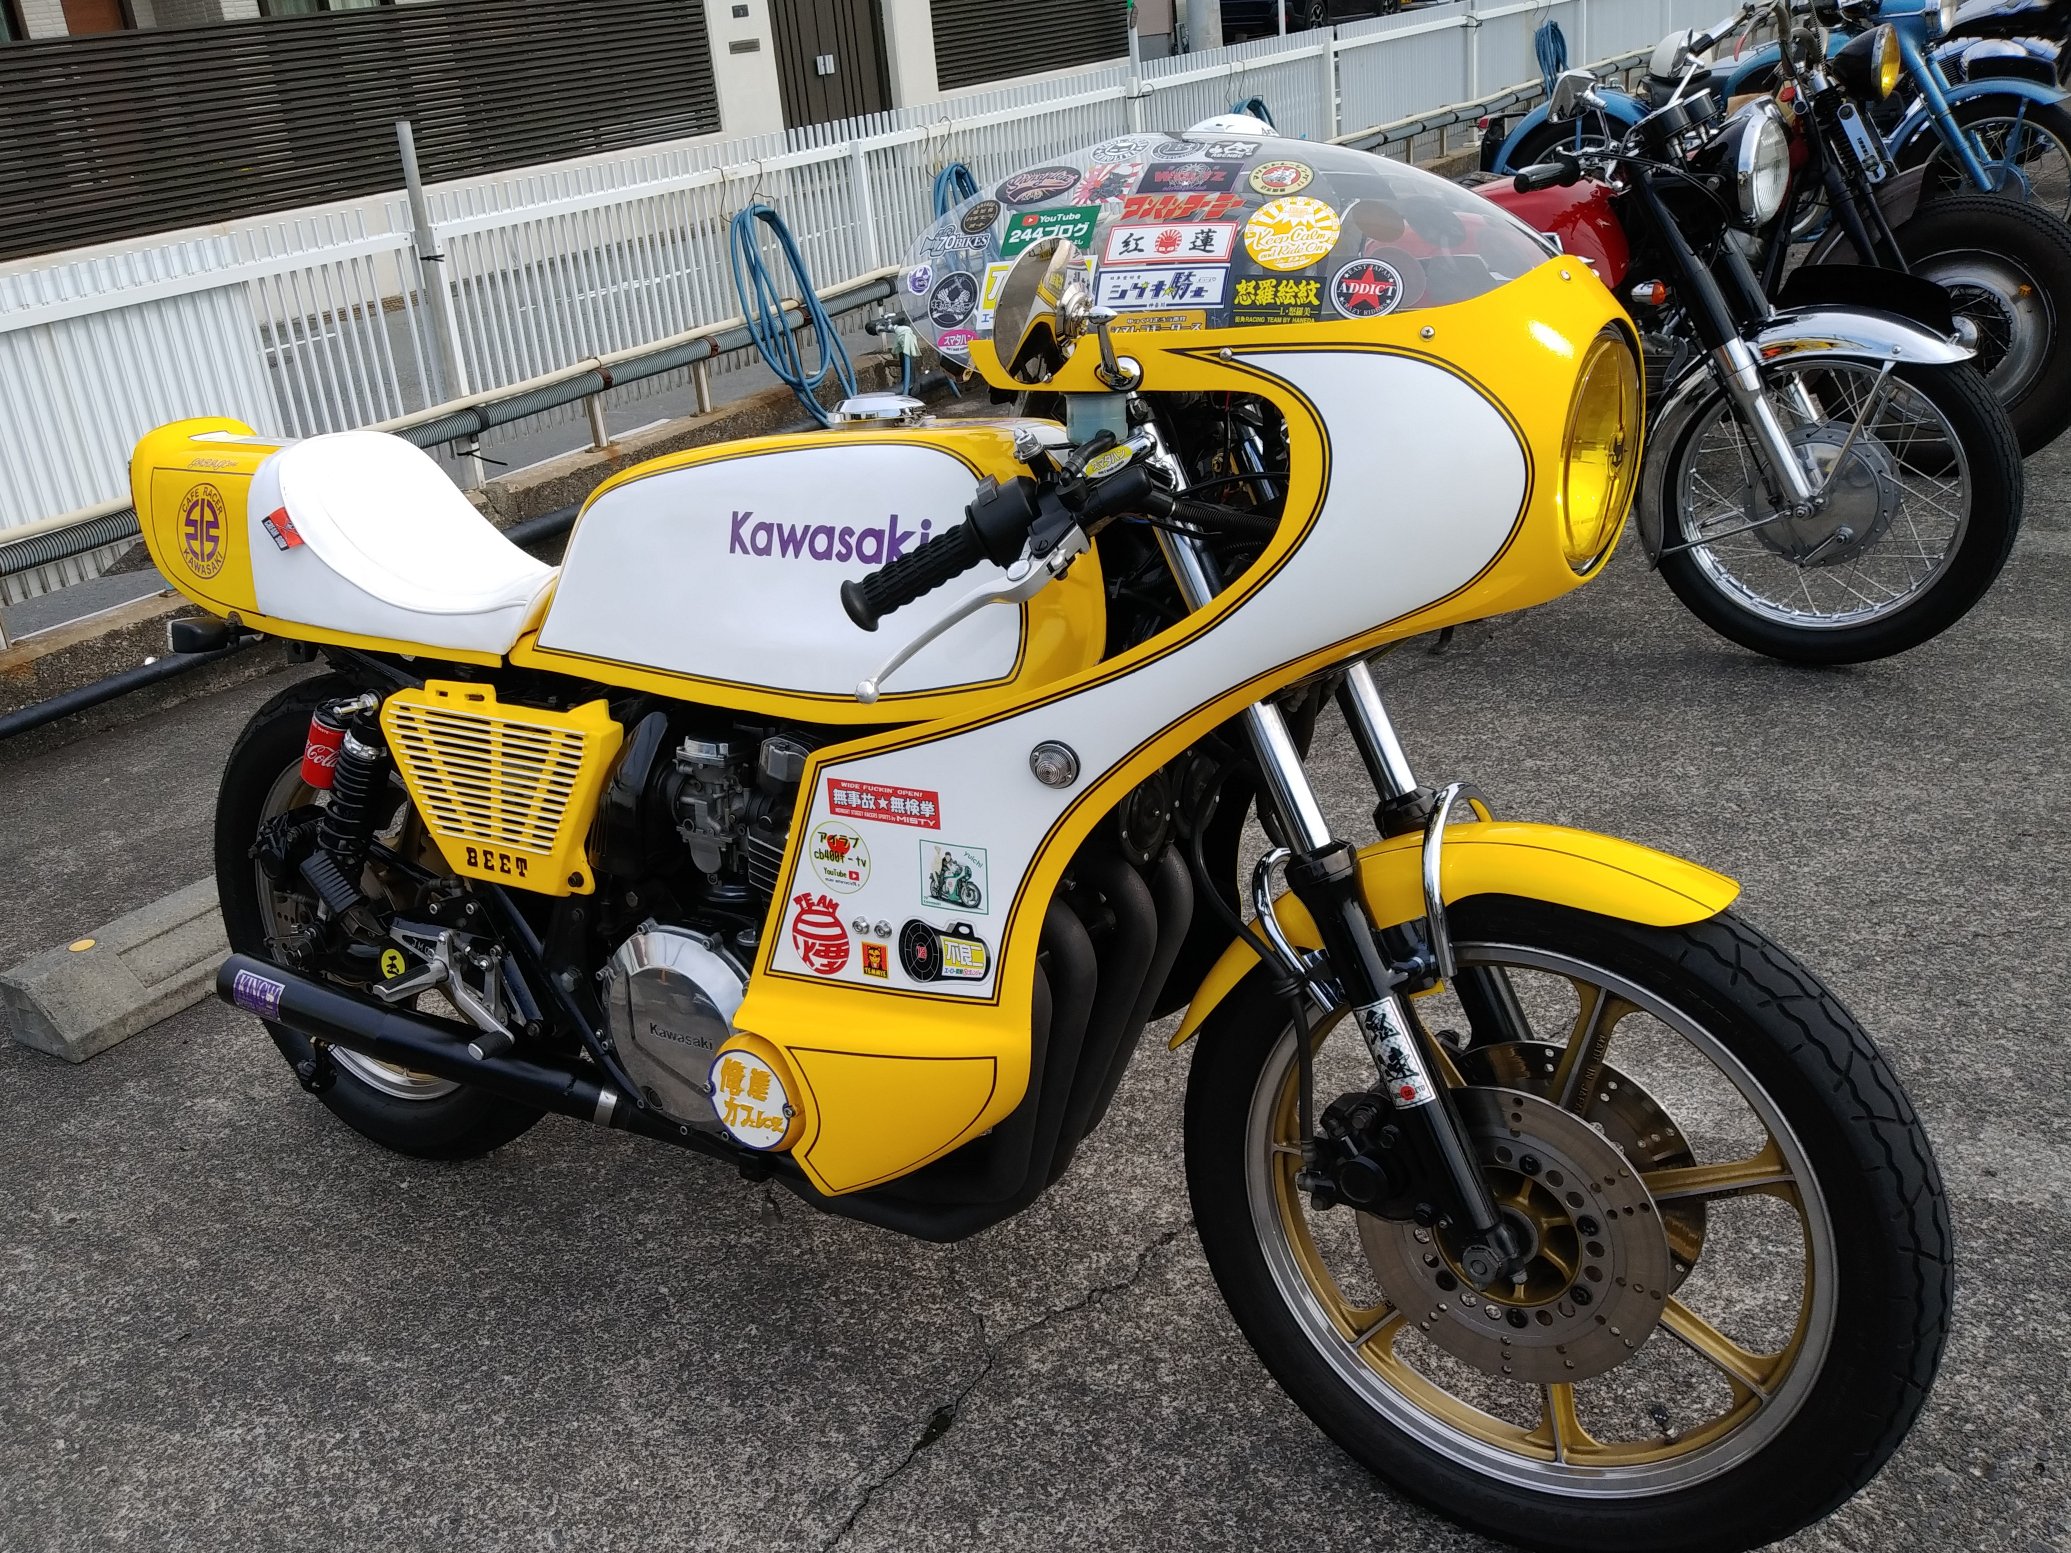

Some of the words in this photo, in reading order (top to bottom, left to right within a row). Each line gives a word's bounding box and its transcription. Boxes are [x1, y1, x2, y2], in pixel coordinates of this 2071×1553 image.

[1040, 213, 1080, 223] YouTube
[1009, 222, 1090, 243] 244ブログ
[1292, 226, 1326, 241] Calm
[1348, 264, 1367, 275] EAST
[1370, 264, 1393, 279] JAPAN
[1337, 281, 1396, 296] ADDICT
[1341, 299, 1361, 315] CRAZY
[1363, 302, 1387, 316] RIDERS
[182, 489, 200, 514] CAFE
[202, 486, 223, 516] RACER
[729, 511, 932, 564] Kawasaki
[183, 550, 224, 576] KAWASAKI
[840, 781, 860, 790] WIDE
[863, 785, 894, 793] FUCKIN'
[897, 789, 923, 797] OPEN!
[896, 815, 936, 827] MISTY
[466, 847, 528, 877] BEET
[823, 866, 847, 878] YouTube
[793, 892, 840, 911] TEAM
[649, 1022, 713, 1051] Kawasaki
